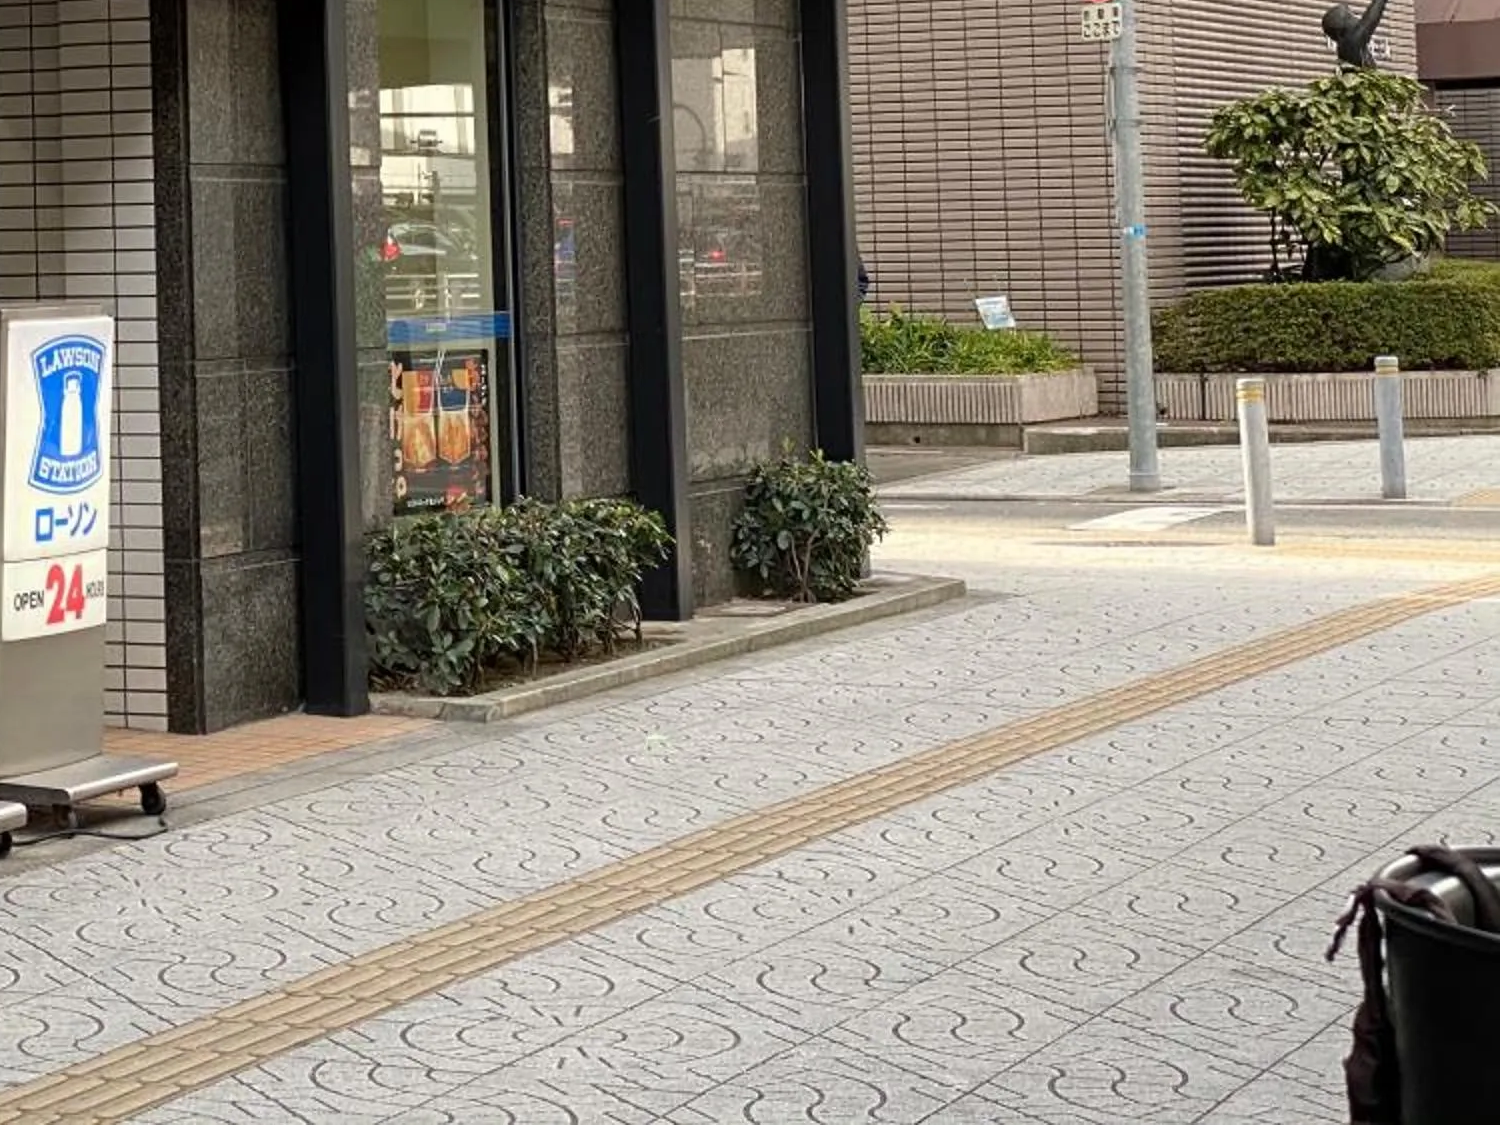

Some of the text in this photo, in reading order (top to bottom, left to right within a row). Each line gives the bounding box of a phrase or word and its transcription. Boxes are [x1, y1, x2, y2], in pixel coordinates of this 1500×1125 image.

[40, 347, 101, 378] LAWSON
[39, 452, 98, 483] STATION
[36, 502, 97, 542] ローソン
[14, 588, 45, 612] OPEN
[45, 563, 86, 626] 24
